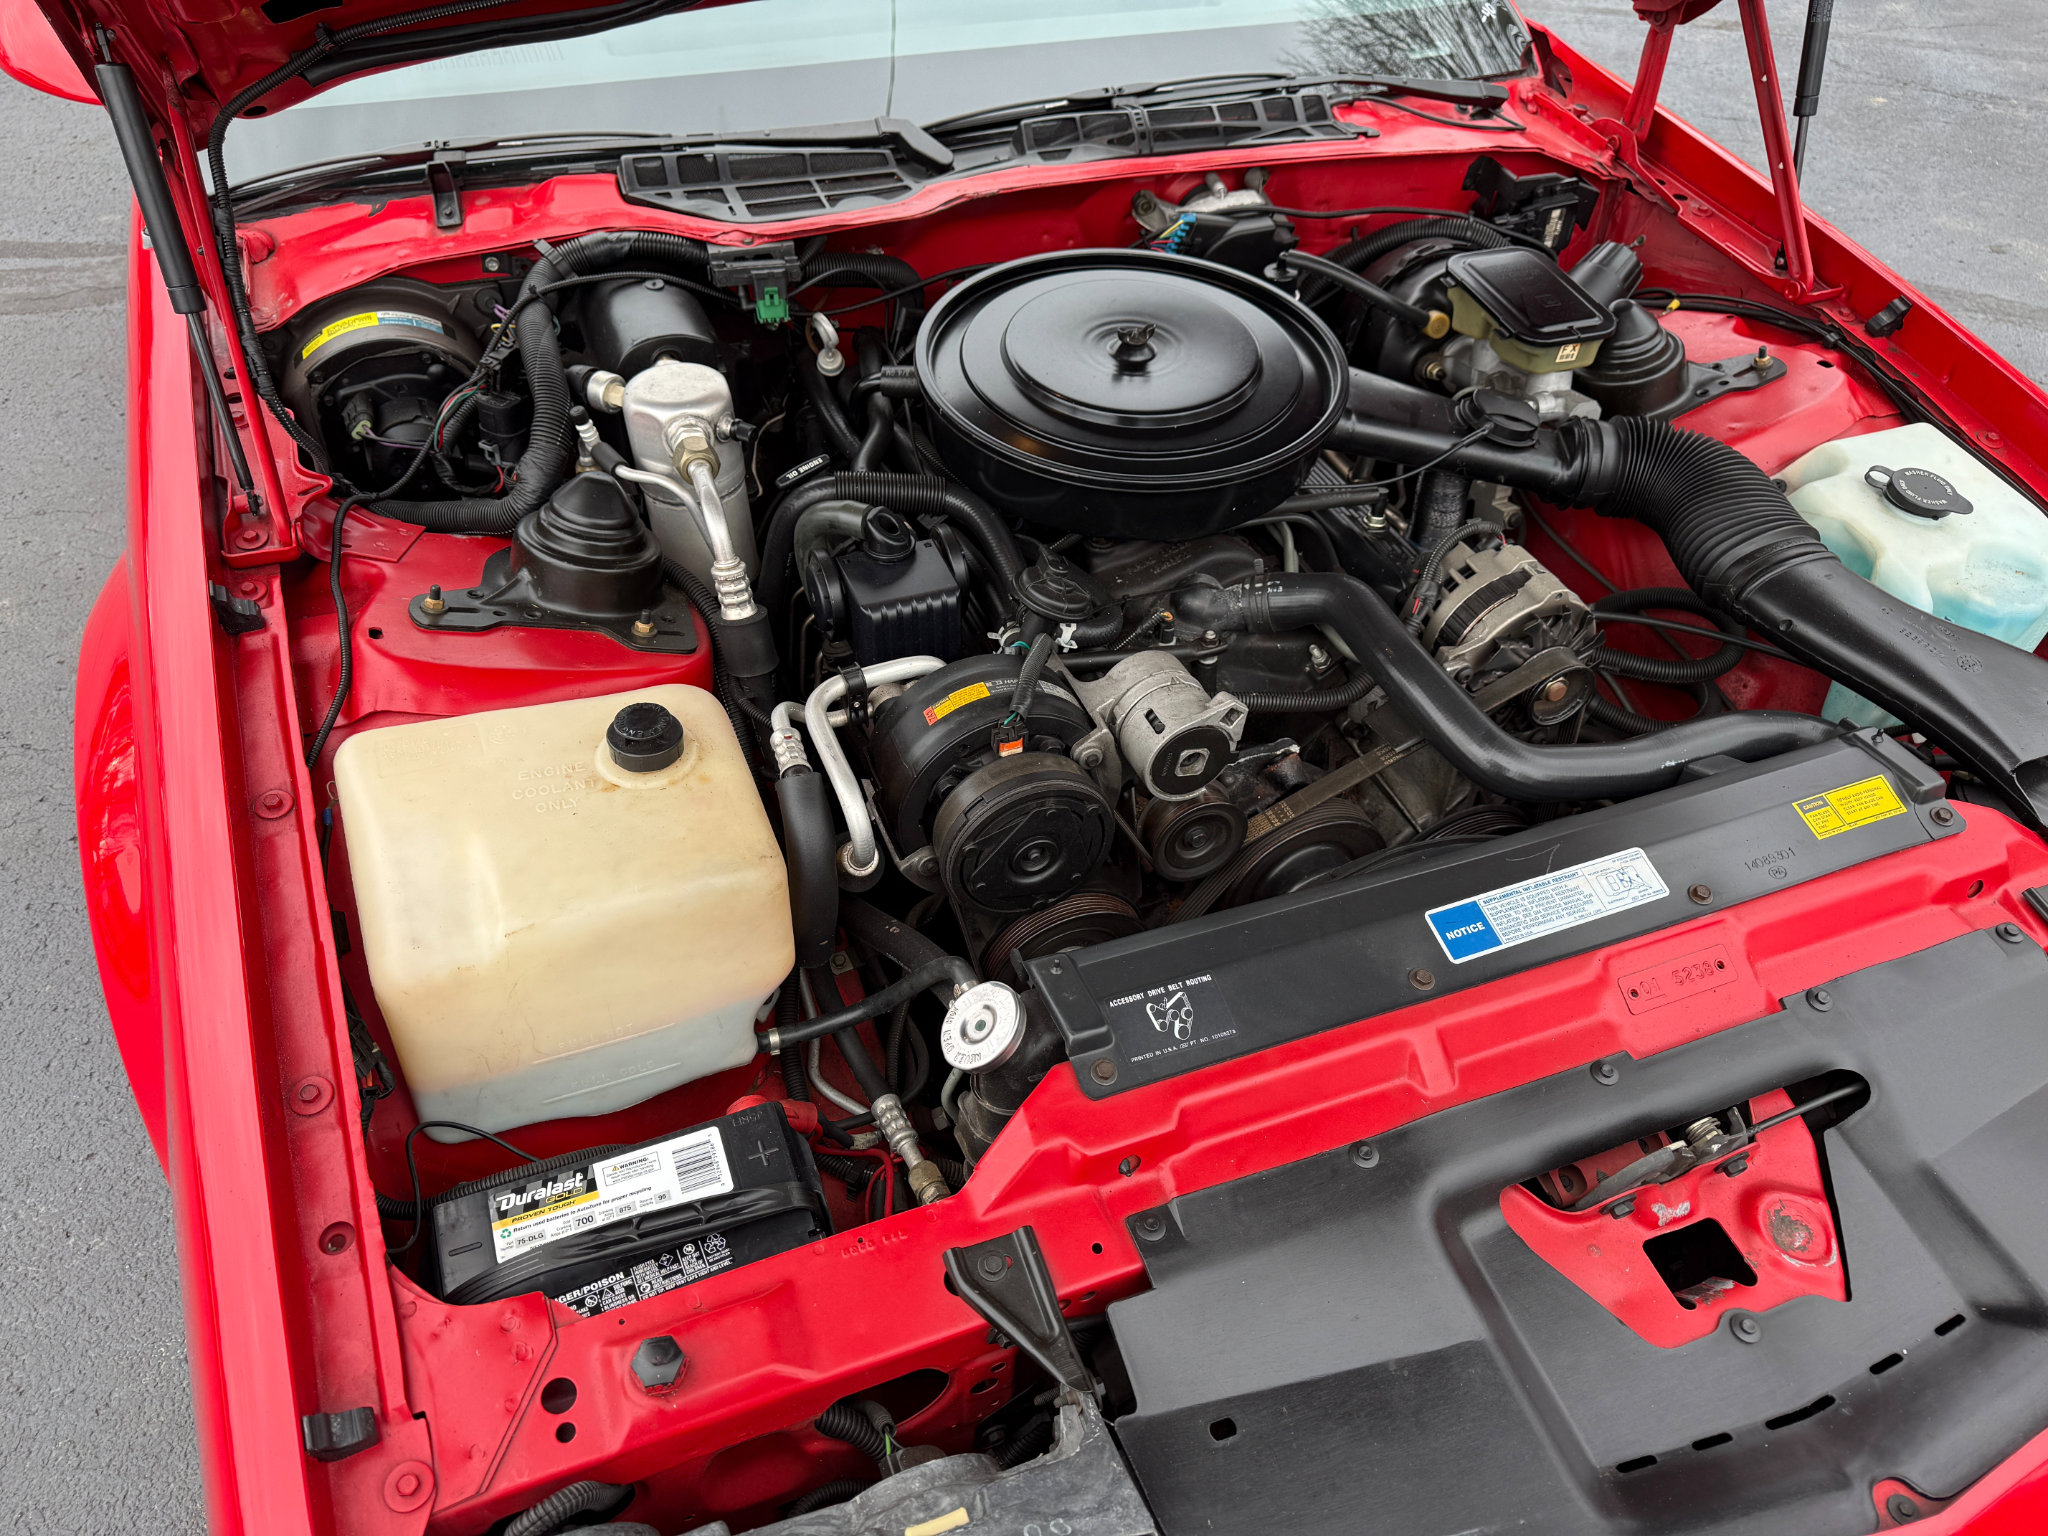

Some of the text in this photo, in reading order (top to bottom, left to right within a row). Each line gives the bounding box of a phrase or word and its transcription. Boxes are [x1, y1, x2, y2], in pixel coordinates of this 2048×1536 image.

[786, 458, 823, 479] ENGINE OIL
[1930, 474, 1946, 485] FLUID
[1944, 485, 1953, 496] ONLY
[1906, 490, 1921, 500] FLUID
[517, 761, 587, 782] ENGINE
[512, 778, 596, 800] COOLANT
[535, 797, 580, 814] ONLY
[1802, 800, 1824, 810] CAUTION
[1744, 847, 1796, 872] 14089301
[1482, 872, 1579, 903] SUPPLEMENTAL INFLATABLE RESTRAINT
[1489, 885, 1580, 916] SUPPLEMENTAL INFLATABLE RESTRAINT
[1498, 899, 1519, 908] VEHICLE
[1525, 889, 1550, 900] EQUIPPED
[1534, 898, 1557, 908] PREVENT
[1557, 890, 1584, 901] UNWANTED
[1542, 903, 1562, 912] SERVICE
[1563, 896, 1582, 906] MANUAL
[1498, 919, 1528, 932] DIAGNOSTIC
[1540, 909, 1560, 919] SERVICE
[1561, 898, 1593, 912] PROCEDURES
[1446, 922, 1485, 940] NOTICE
[1501, 927, 1522, 937] BEFORE
[1522, 917, 1554, 930] PERFORMING
[1108, 974, 1212, 1007] ACCESSORY DRIVE BELT ROUTING
[1130, 1052, 1153, 1062] PRINTED
[619, 1060, 656, 1075] COLD
[496, 1172, 584, 1212] Duralast
[545, 1186, 583, 1204] GOLD
[511, 1200, 576, 1223] PROVEN TOUGH
[513, 1224, 531, 1233] Return
[533, 1220, 546, 1228] used
[546, 1212, 570, 1224] batteries
[577, 1202, 602, 1214] AutoZone
[610, 1193, 630, 1204] proper
[630, 1186, 652, 1197] recycling
[575, 1214, 594, 1227] 700
[516, 1232, 544, 1245] 75-DLG
[686, 1273, 697, 1281] CAPS
[697, 1268, 709, 1276] TIGHT
[556, 1272, 625, 1303] GER/POISON
[602, 1294, 626, 1306] CAN CAUSE
